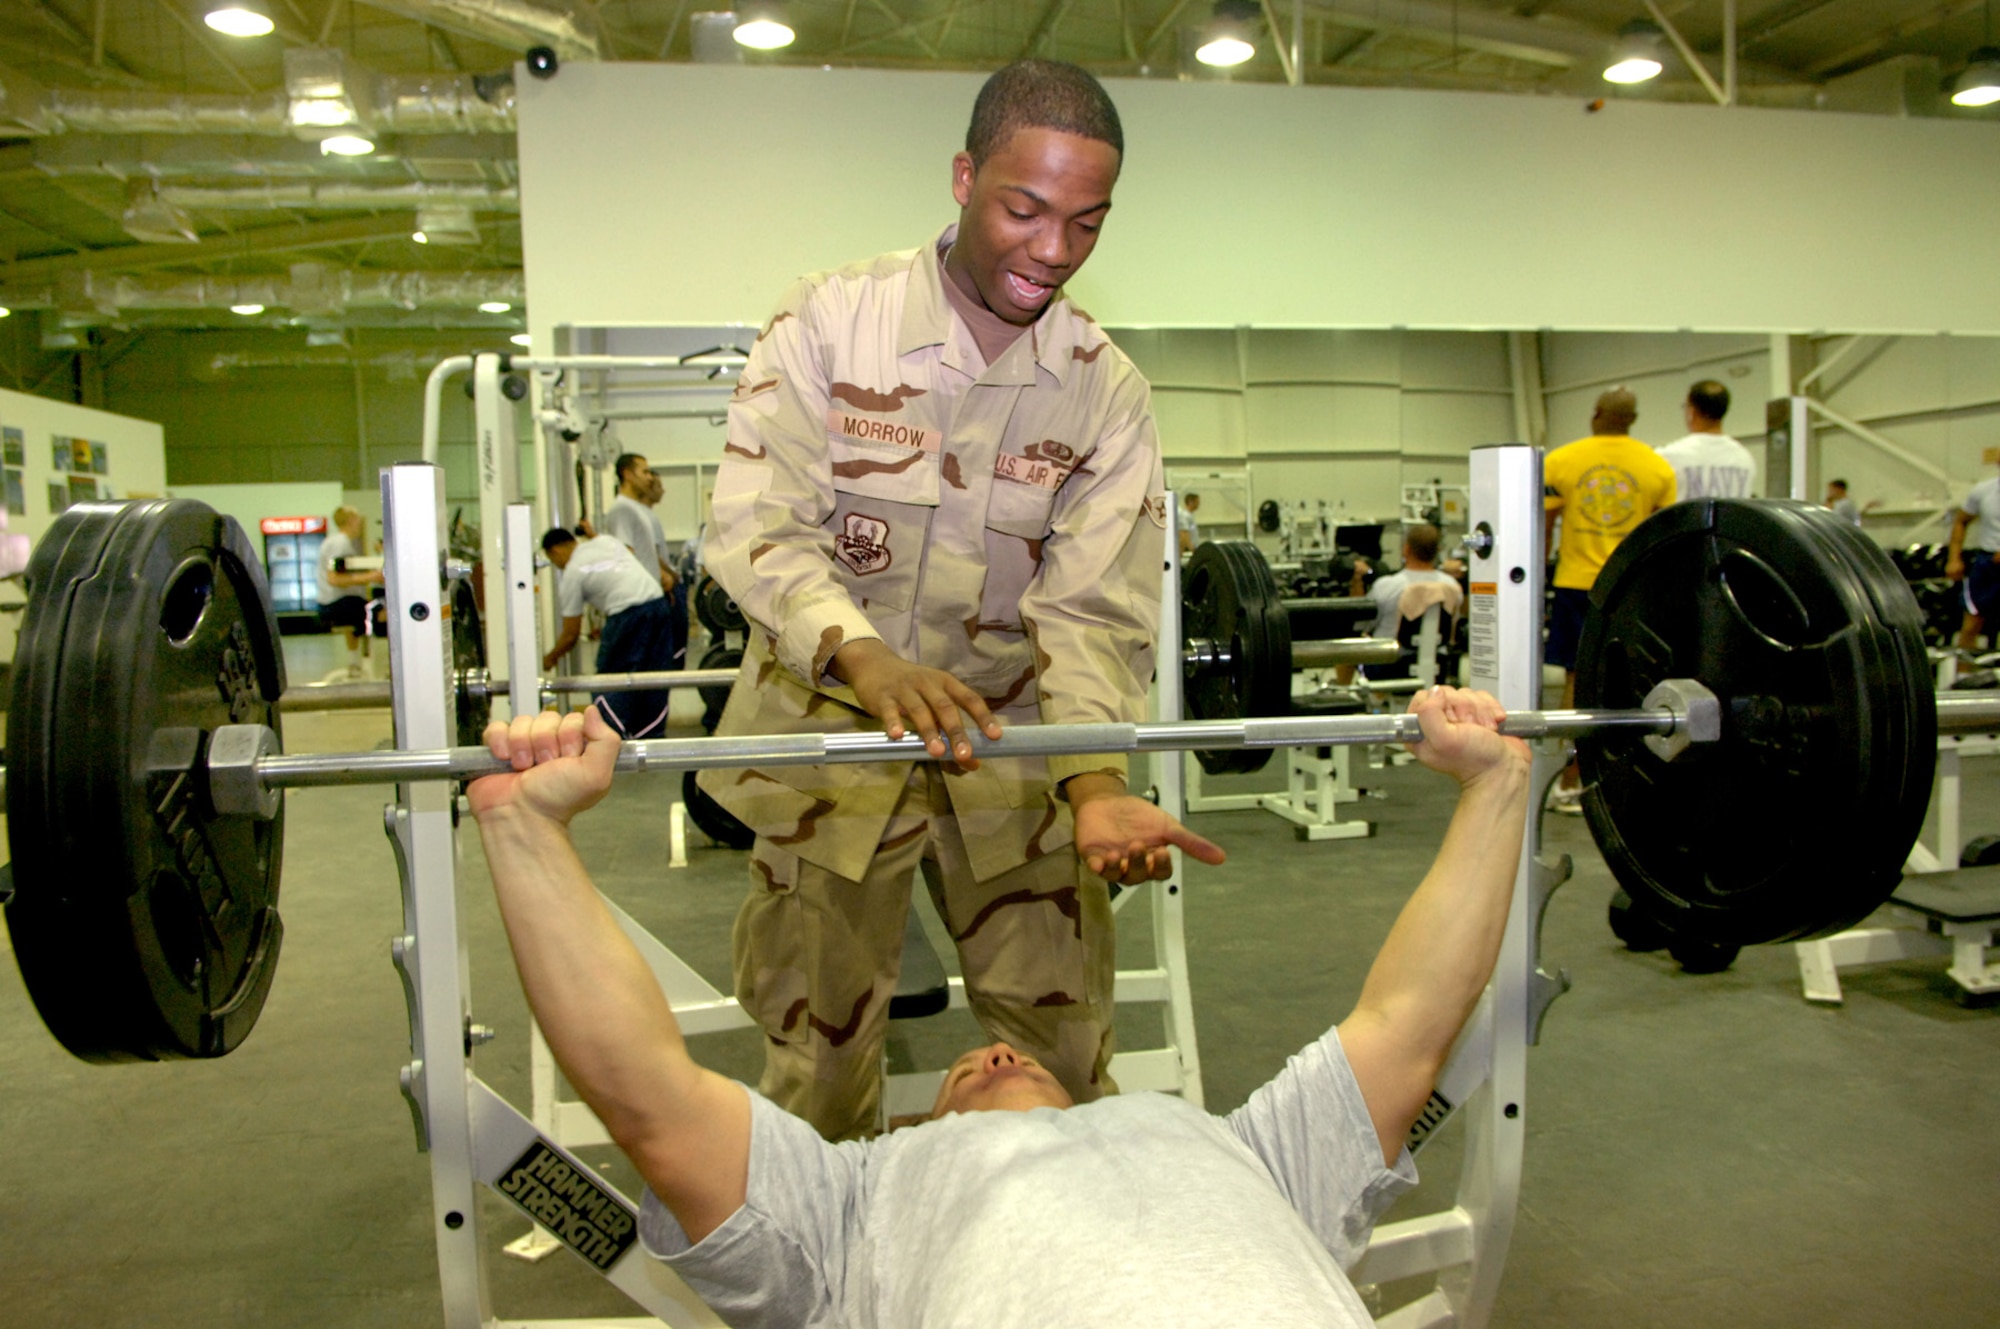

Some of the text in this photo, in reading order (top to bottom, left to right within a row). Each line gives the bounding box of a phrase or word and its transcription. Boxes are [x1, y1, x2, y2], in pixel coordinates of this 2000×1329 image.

[843, 416, 924, 447] MORROW
[994, 453, 1017, 477] U.S.
[1025, 463, 1048, 486] AIR
[1684, 465, 1749, 498] NAVY
[526, 1149, 633, 1241] HAMMER
[501, 1168, 620, 1267] STRENGTH
